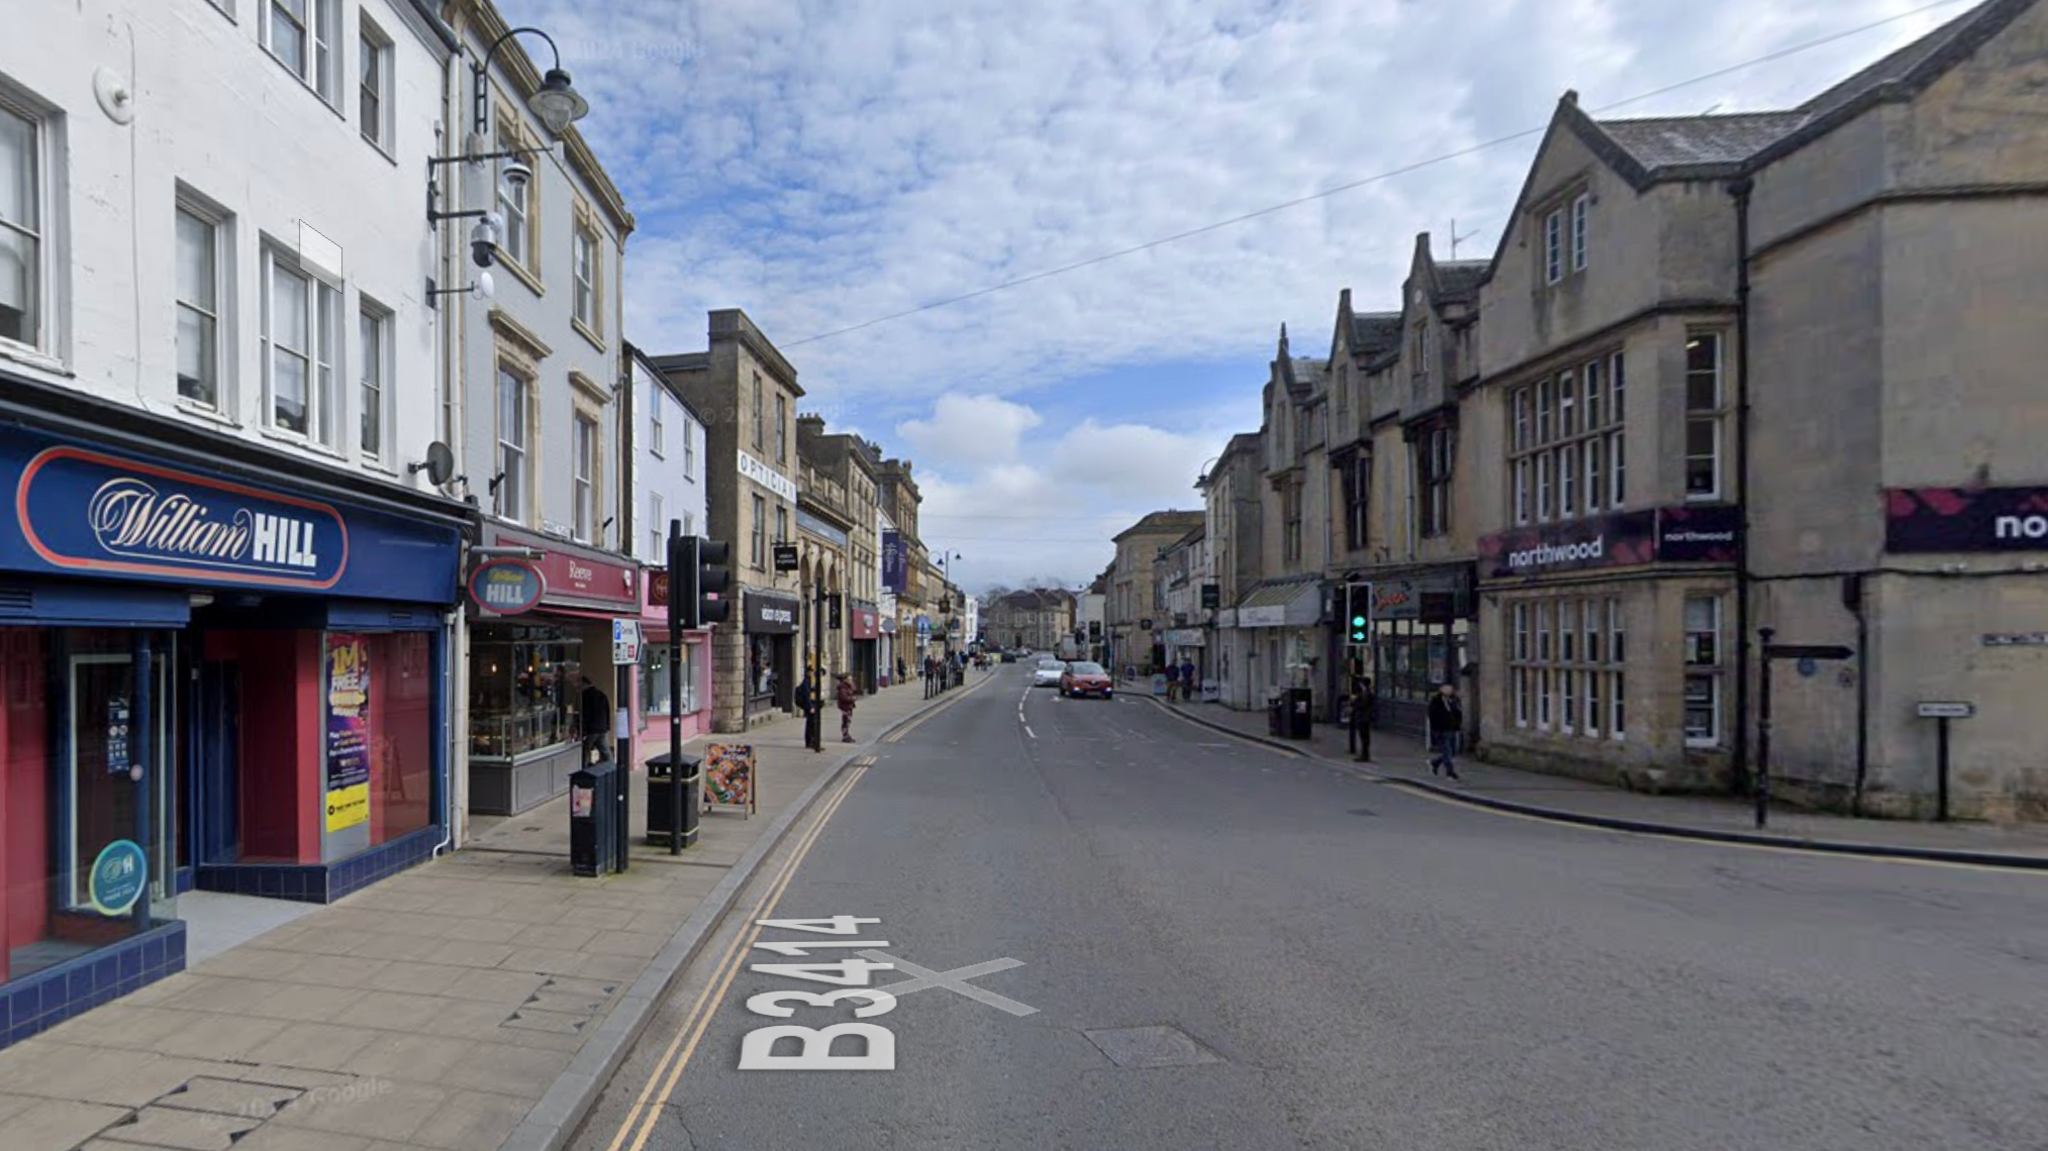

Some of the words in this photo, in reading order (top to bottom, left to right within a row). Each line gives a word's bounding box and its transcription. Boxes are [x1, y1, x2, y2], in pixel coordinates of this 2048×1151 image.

[89, 478, 254, 562] William
[252, 512, 317, 567] HILL
[1664, 531, 1733, 542] northwood
[1508, 534, 1603, 568] northwood
[486, 584, 524, 604] HILL
